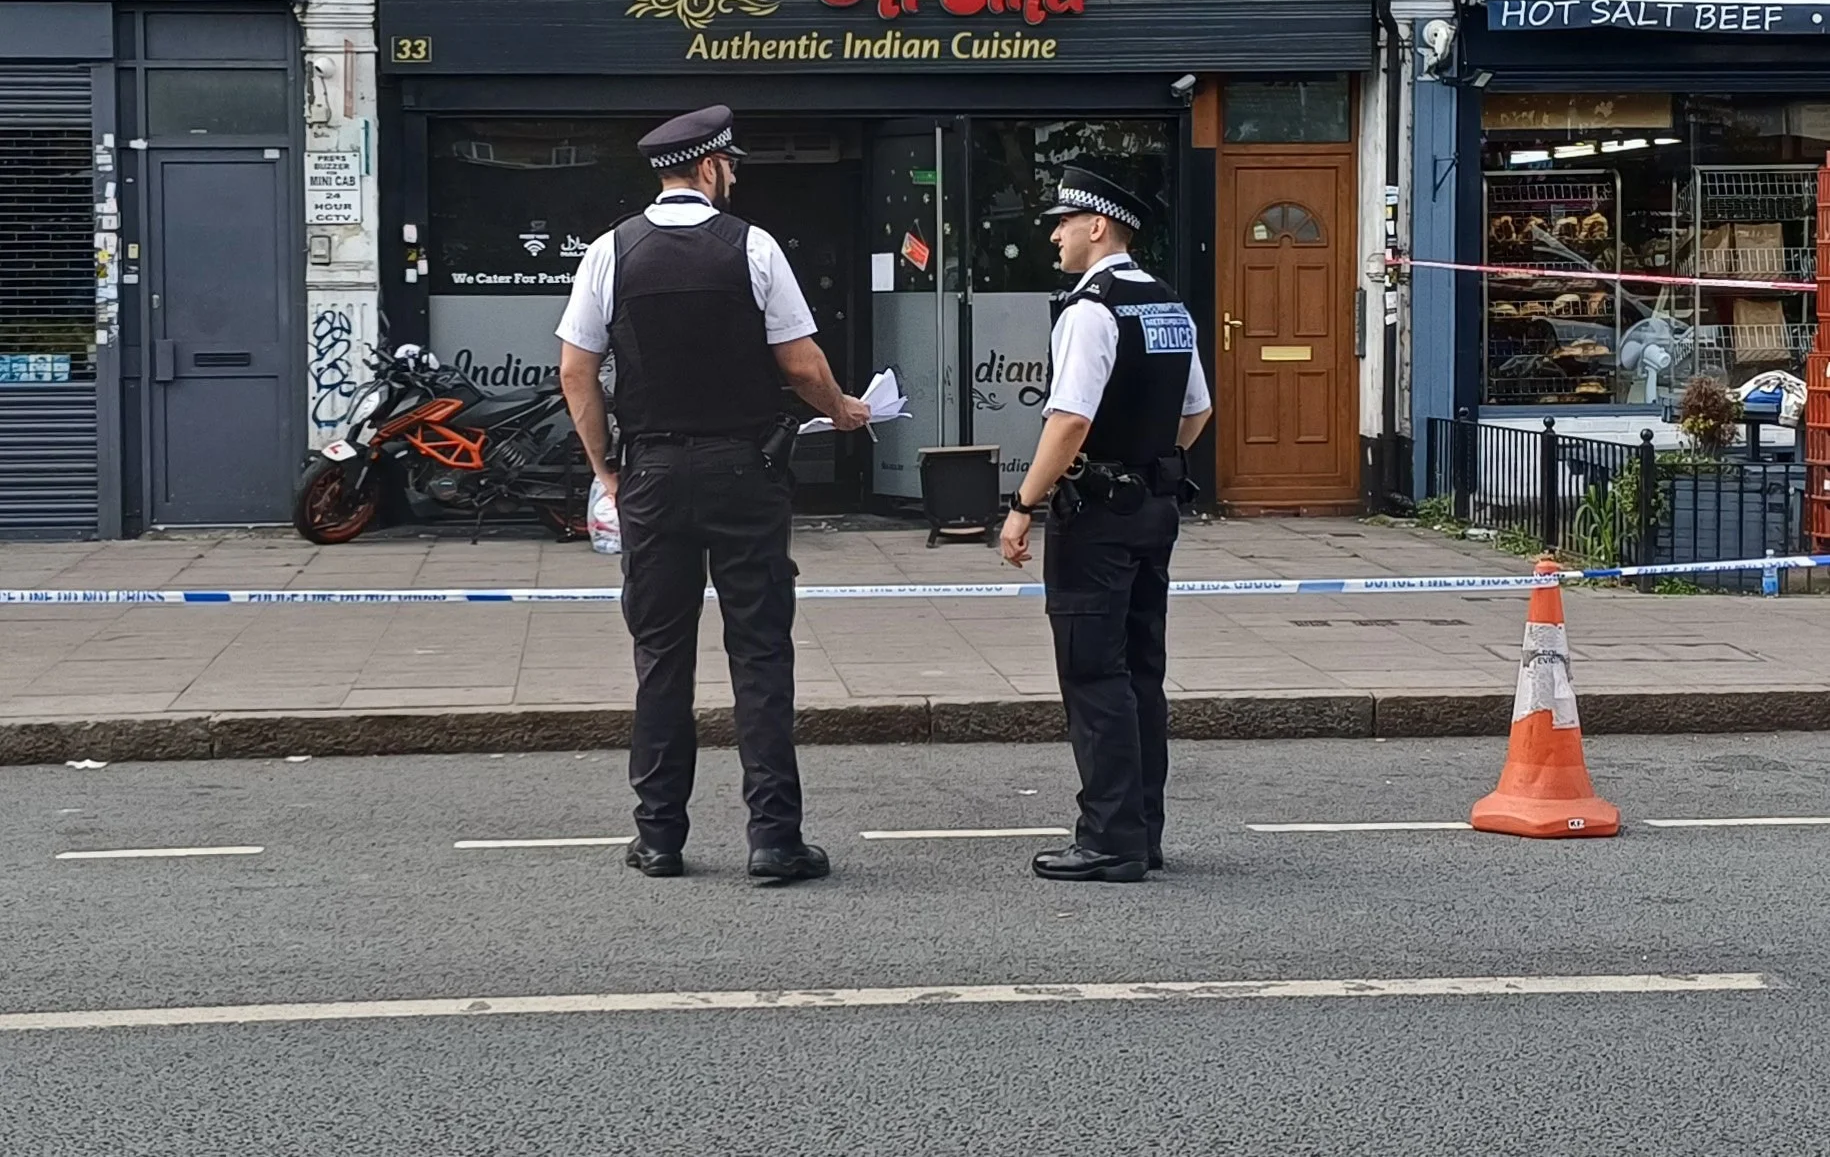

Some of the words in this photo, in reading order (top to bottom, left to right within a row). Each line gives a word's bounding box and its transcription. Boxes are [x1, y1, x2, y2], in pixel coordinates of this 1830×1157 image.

[1500, 0, 1581, 28] HOT
[1590, 0, 1684, 28] SALT
[1694, 3, 1784, 32] BEEF
[396, 39, 427, 60] 33
[685, 31, 833, 61] Authentic
[843, 31, 940, 60] Indian
[951, 31, 1057, 60] Cuisine
[309, 176, 332, 187] MINI
[335, 176, 356, 187] CAB
[314, 203, 352, 211] HOUR
[451, 272, 474, 284] We
[475, 272, 512, 284] Cater
[513, 272, 537, 284] For
[1147, 327, 1193, 349] POLICE
